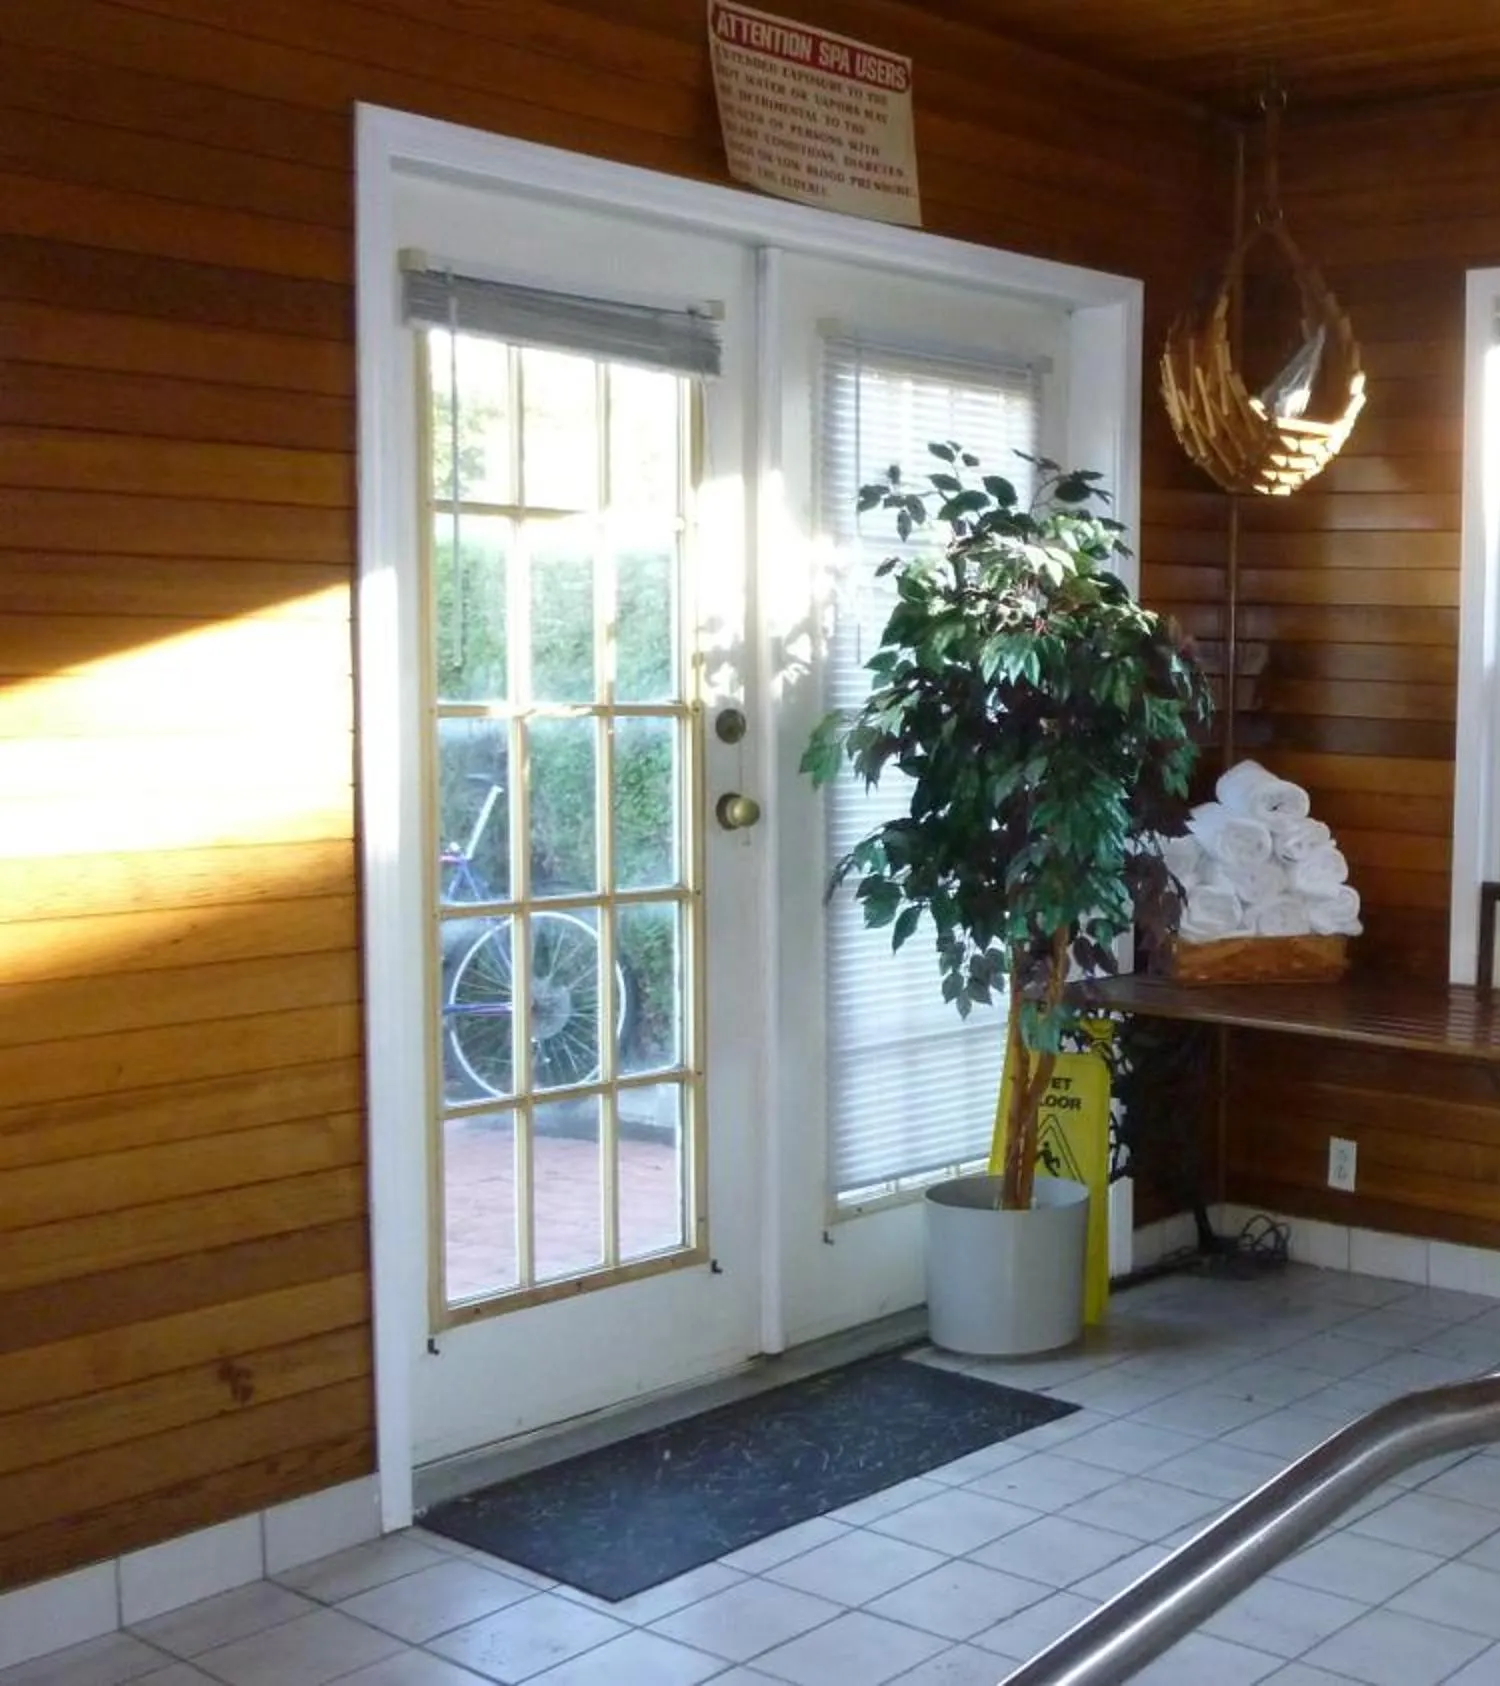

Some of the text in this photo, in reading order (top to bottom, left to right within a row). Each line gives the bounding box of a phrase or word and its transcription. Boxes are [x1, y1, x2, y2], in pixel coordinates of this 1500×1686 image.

[717, 10, 907, 90] ATTENTION SPA USERS
[848, 87, 864, 99] TO
[825, 113, 841, 128] TO
[1040, 1095, 1082, 1111] OOR
